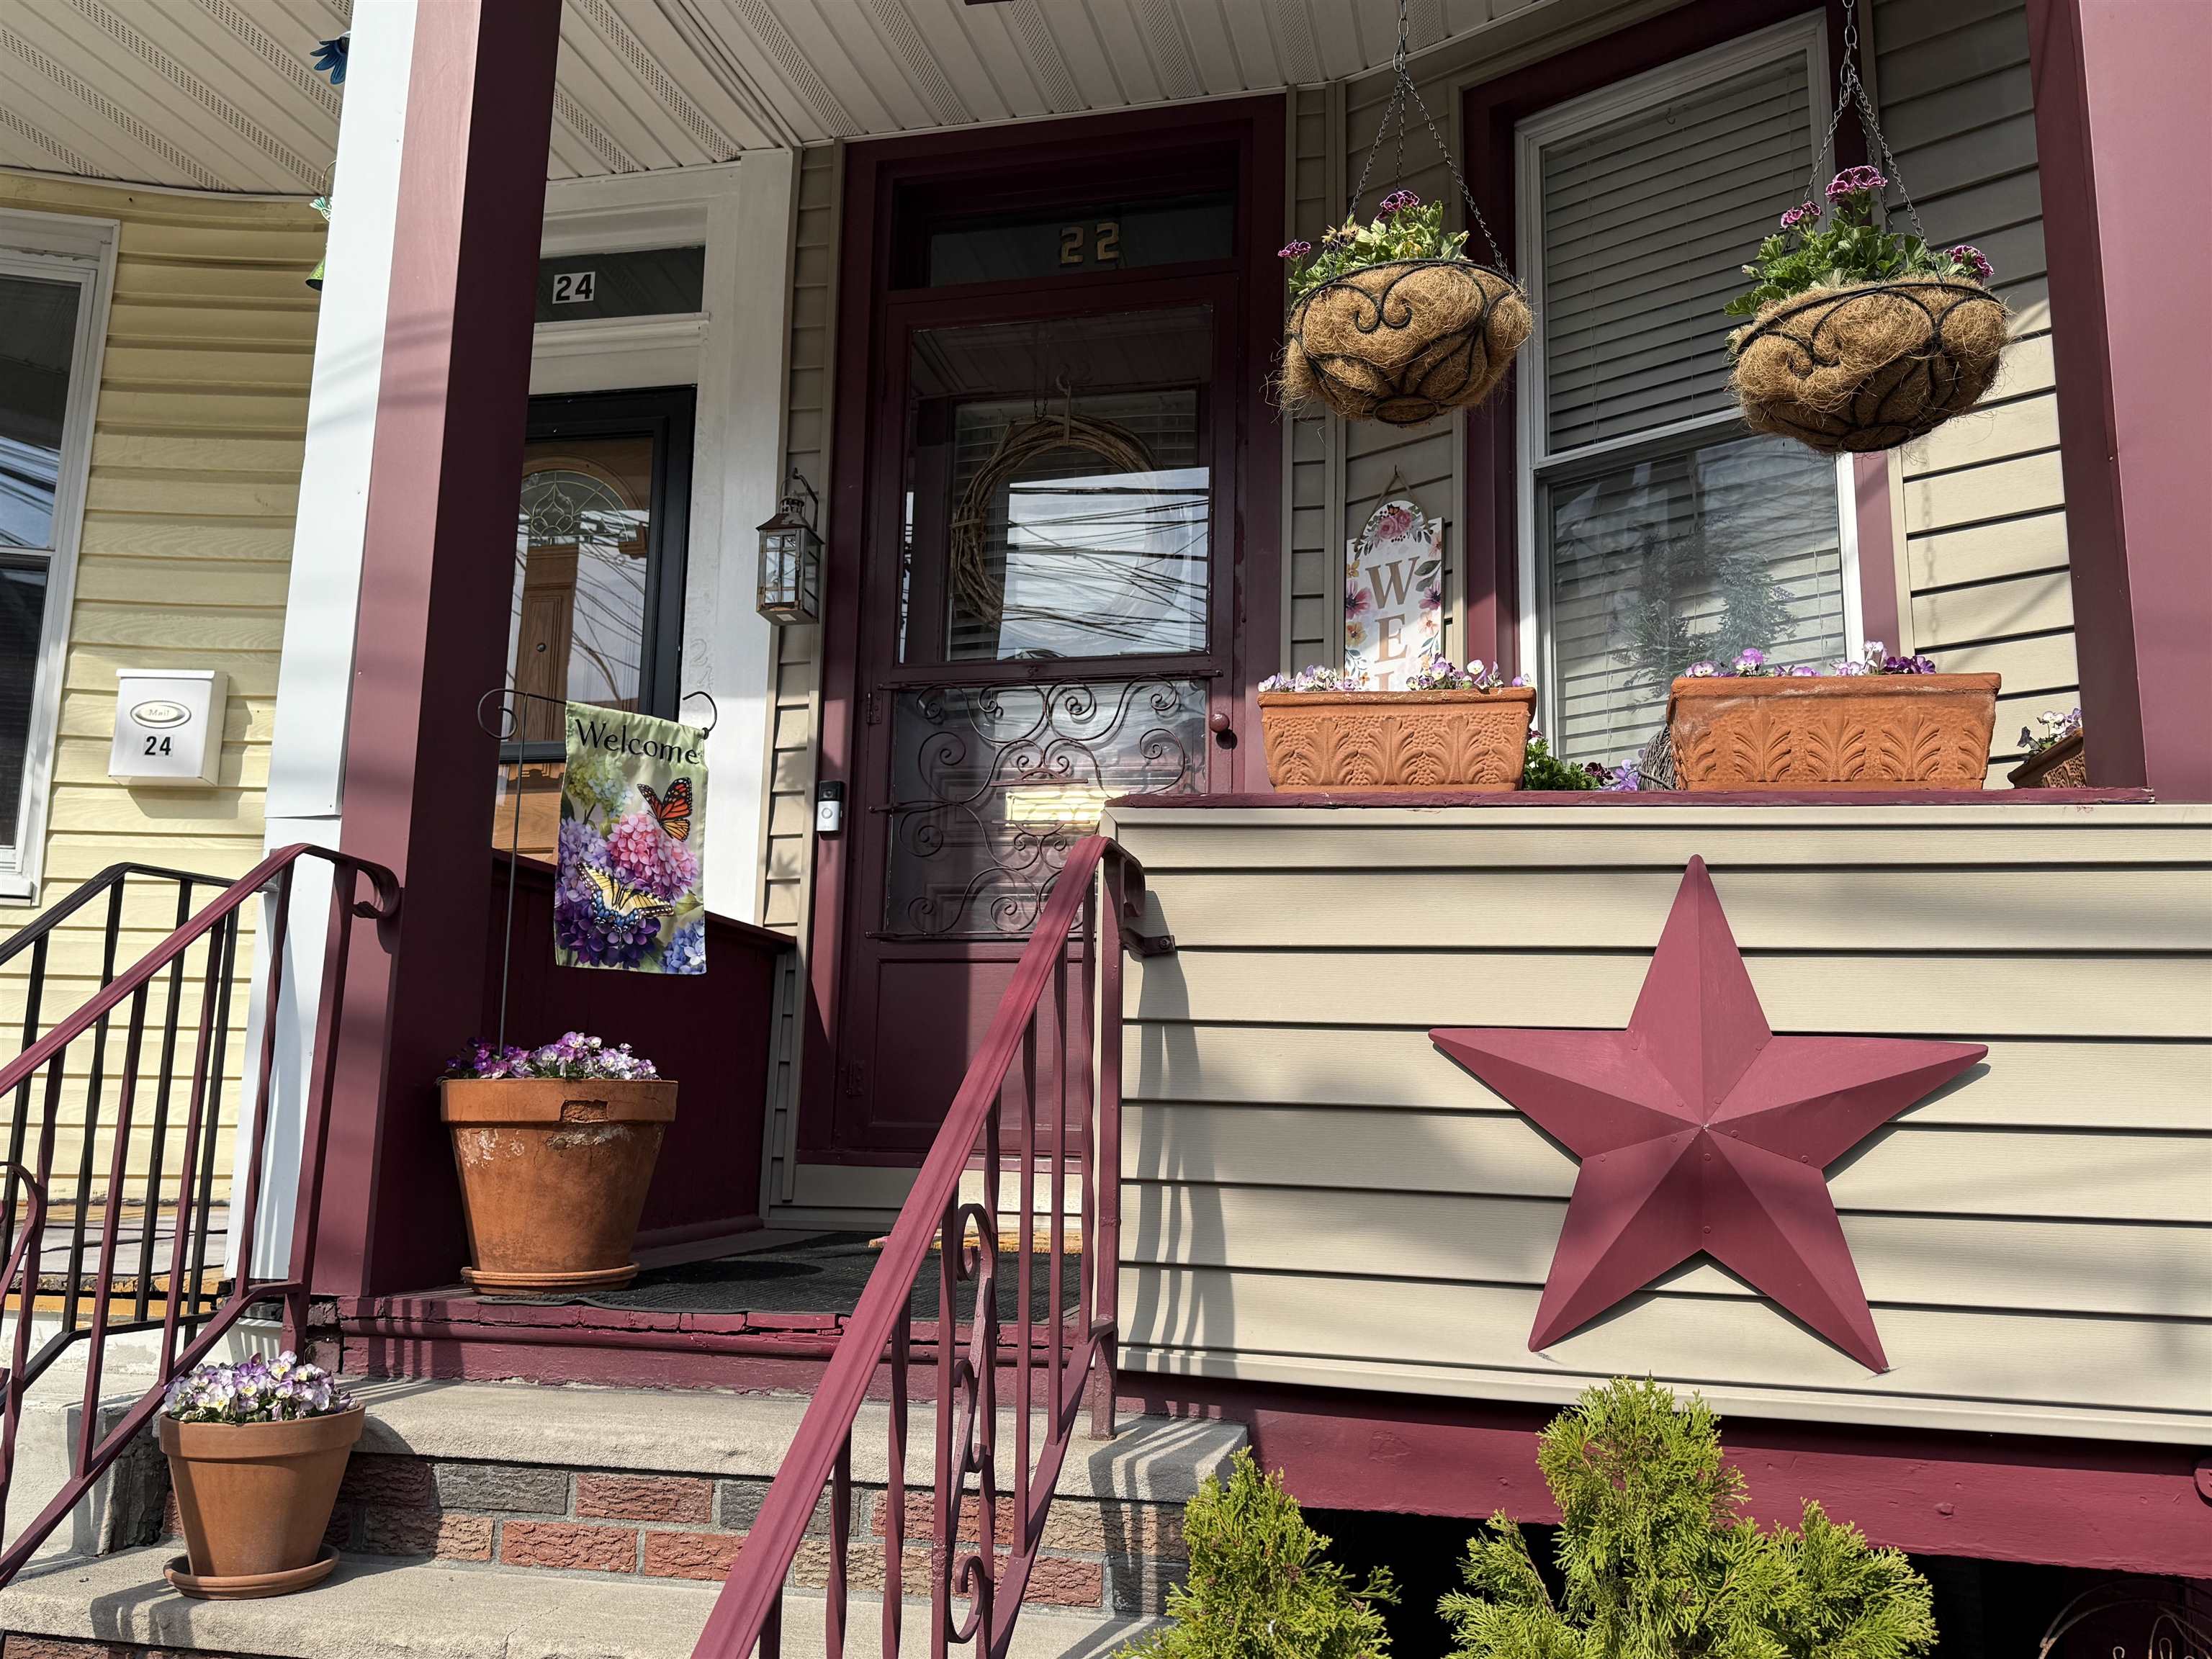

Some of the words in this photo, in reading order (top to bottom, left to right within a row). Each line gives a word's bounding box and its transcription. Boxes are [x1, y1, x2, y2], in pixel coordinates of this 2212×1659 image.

[1061, 222, 1118, 264] 22
[556, 274, 592, 301] 24
[145, 736, 171, 755] 24
[575, 719, 700, 765] Welcome
